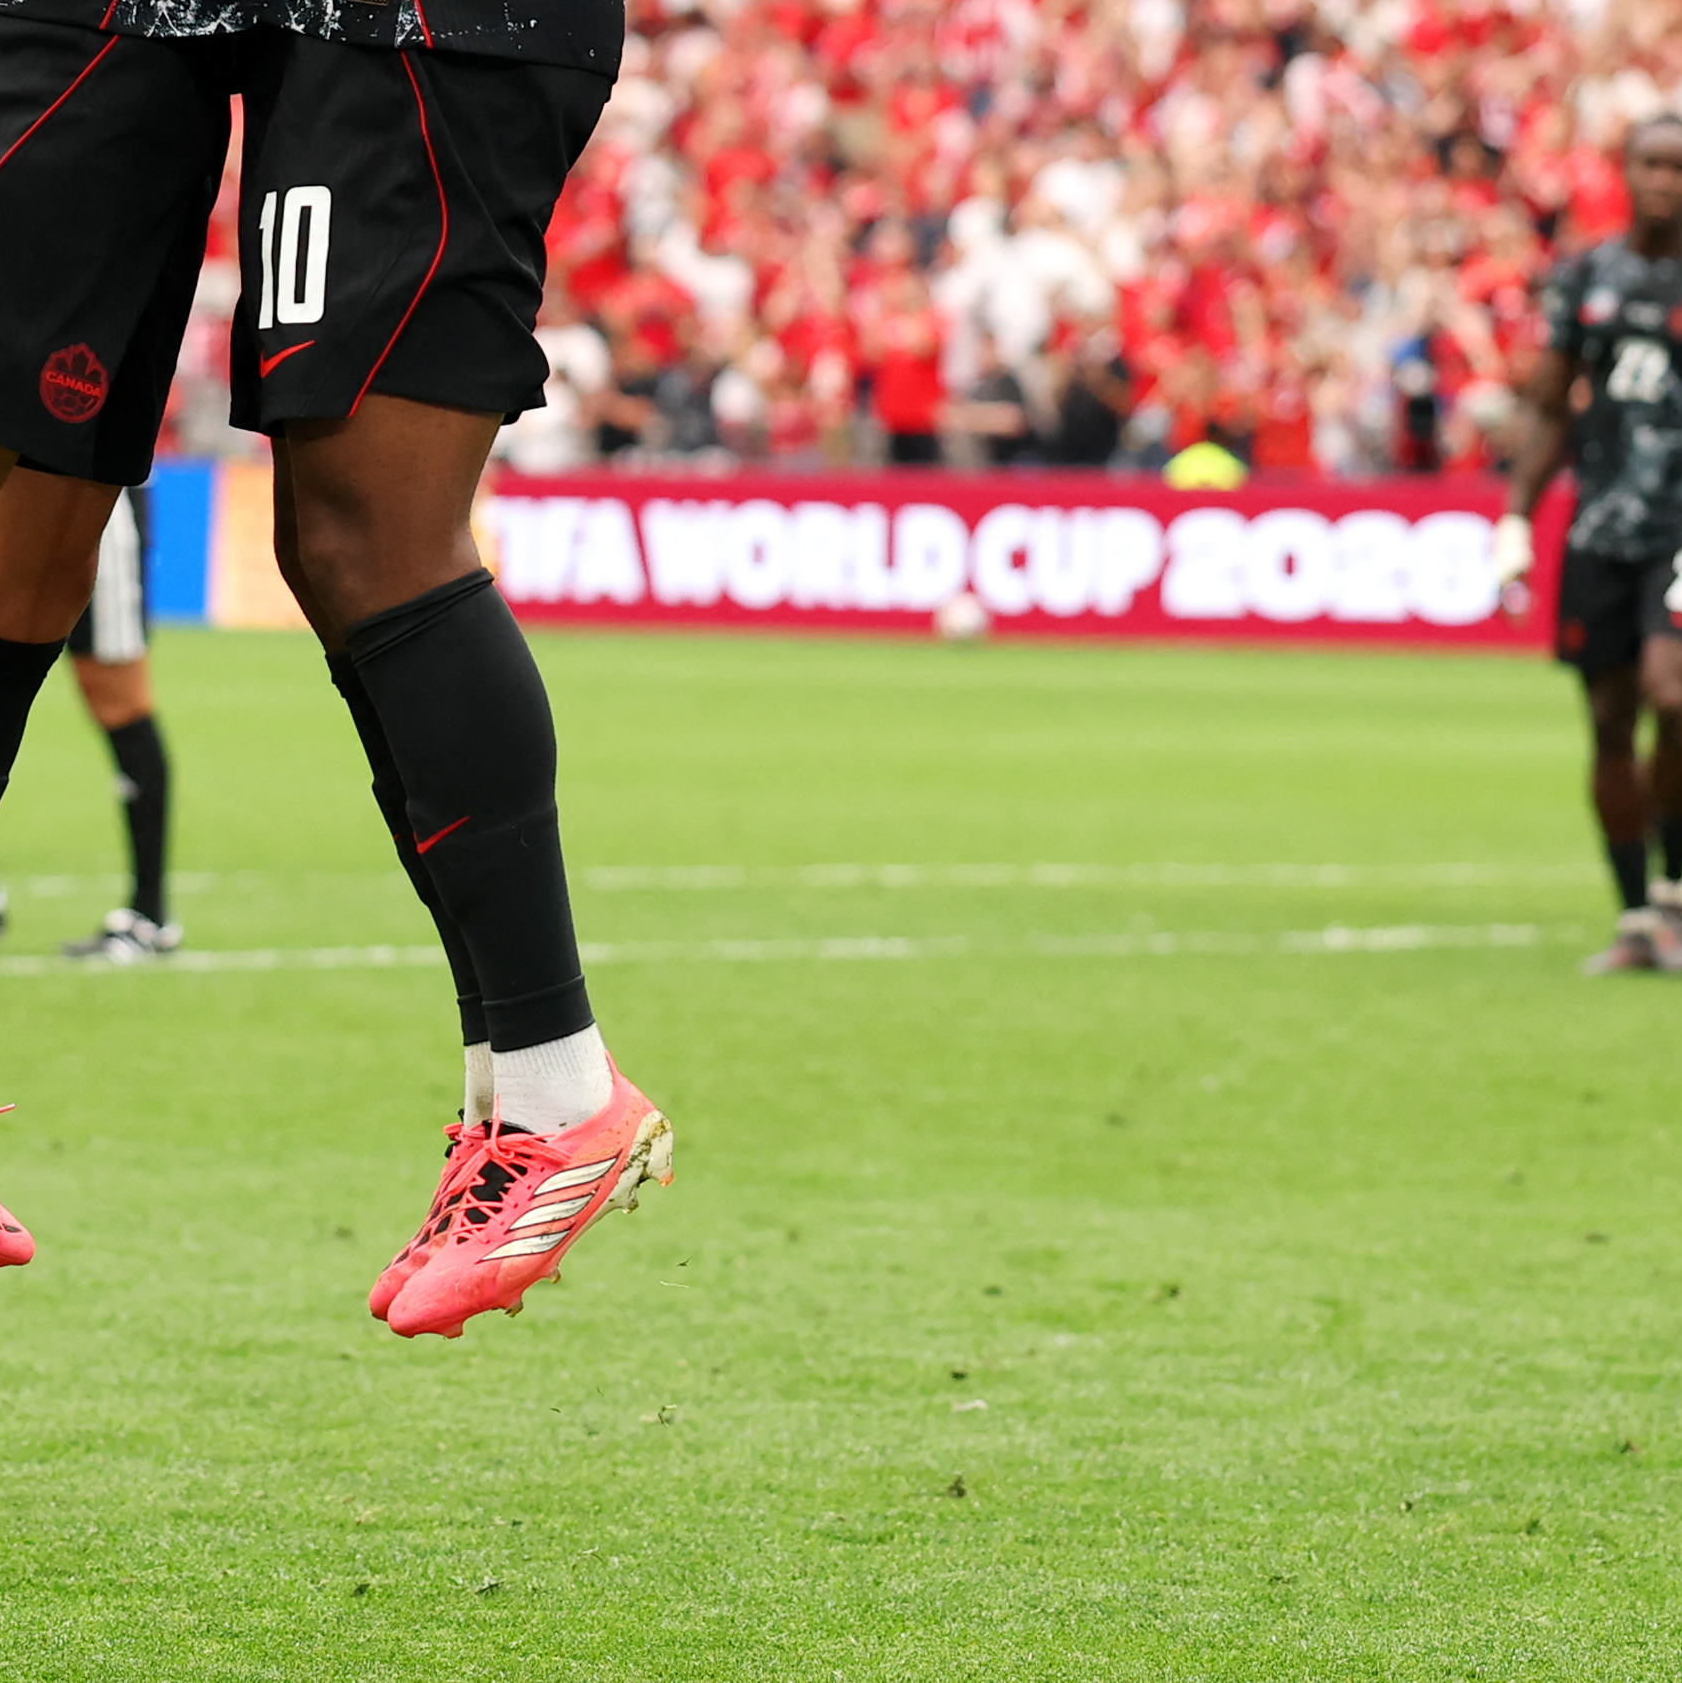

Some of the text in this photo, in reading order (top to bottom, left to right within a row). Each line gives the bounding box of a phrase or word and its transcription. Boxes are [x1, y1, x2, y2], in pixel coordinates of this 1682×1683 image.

[258, 185, 332, 330] 10
[46, 371, 104, 398] CANADA
[639, 498, 972, 612] WORLD
[969, 504, 1166, 618] CUP
[1160, 507, 1505, 626] 2026
